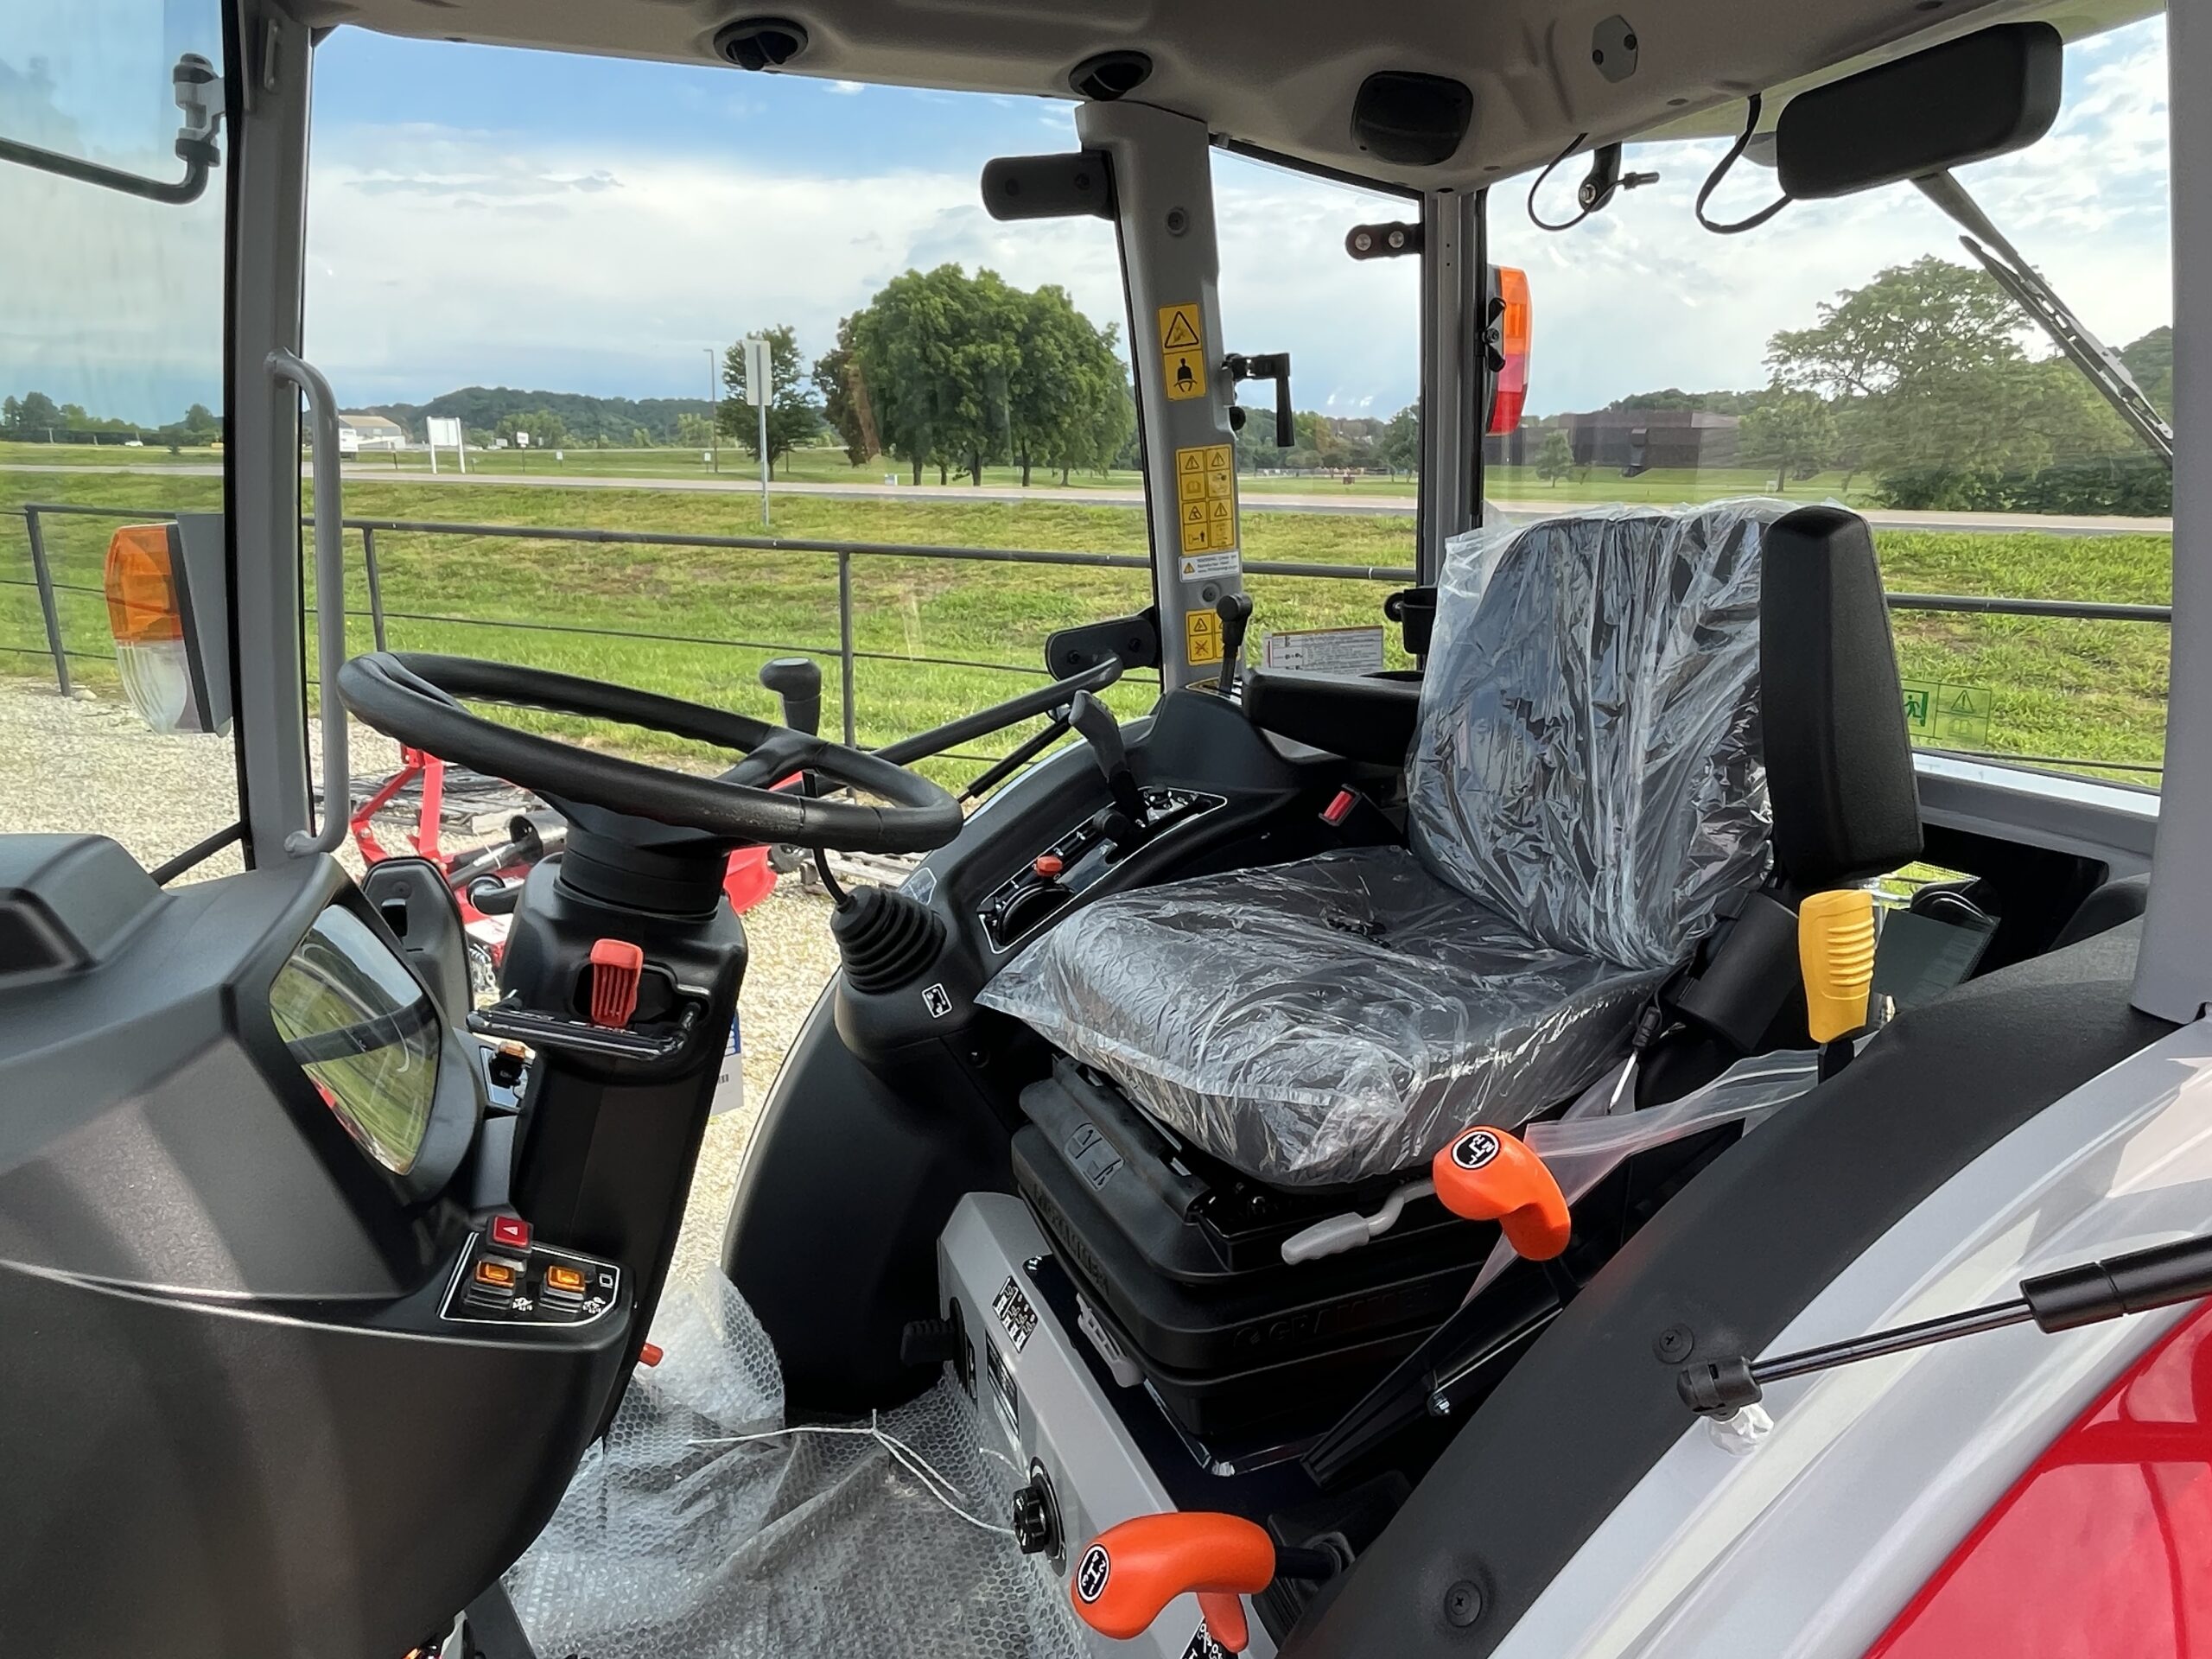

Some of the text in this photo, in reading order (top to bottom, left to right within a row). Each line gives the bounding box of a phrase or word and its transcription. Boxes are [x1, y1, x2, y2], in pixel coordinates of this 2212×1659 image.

[1481, 1141, 1494, 1153] M
[1469, 1154, 1478, 1165] L
[1092, 1551, 1106, 1573] 2 4
[1082, 1574, 1095, 1595] 1 3
